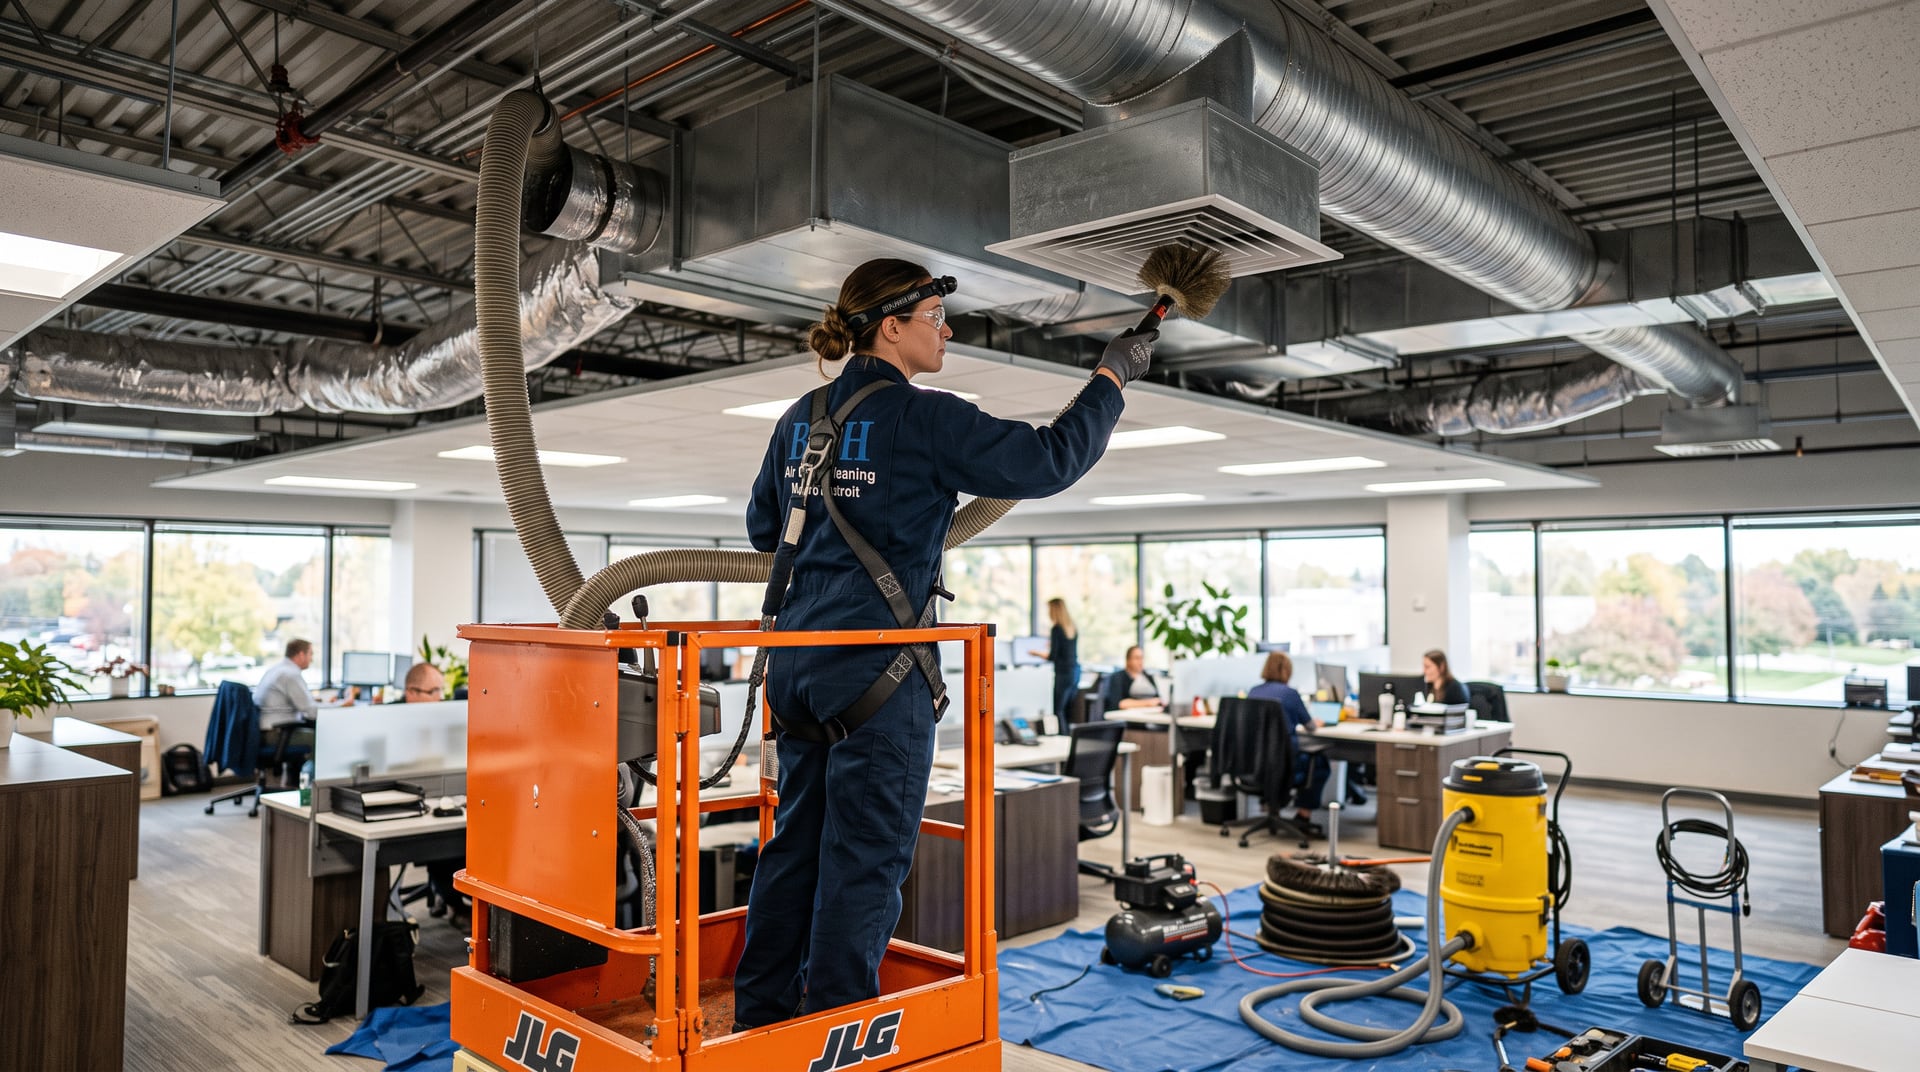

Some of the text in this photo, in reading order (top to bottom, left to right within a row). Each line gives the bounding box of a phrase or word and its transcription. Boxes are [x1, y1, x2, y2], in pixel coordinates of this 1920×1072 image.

[833, 467, 876, 484] leaning
[503, 1010, 581, 1072] JLG
[809, 1008, 904, 1072] JLG
